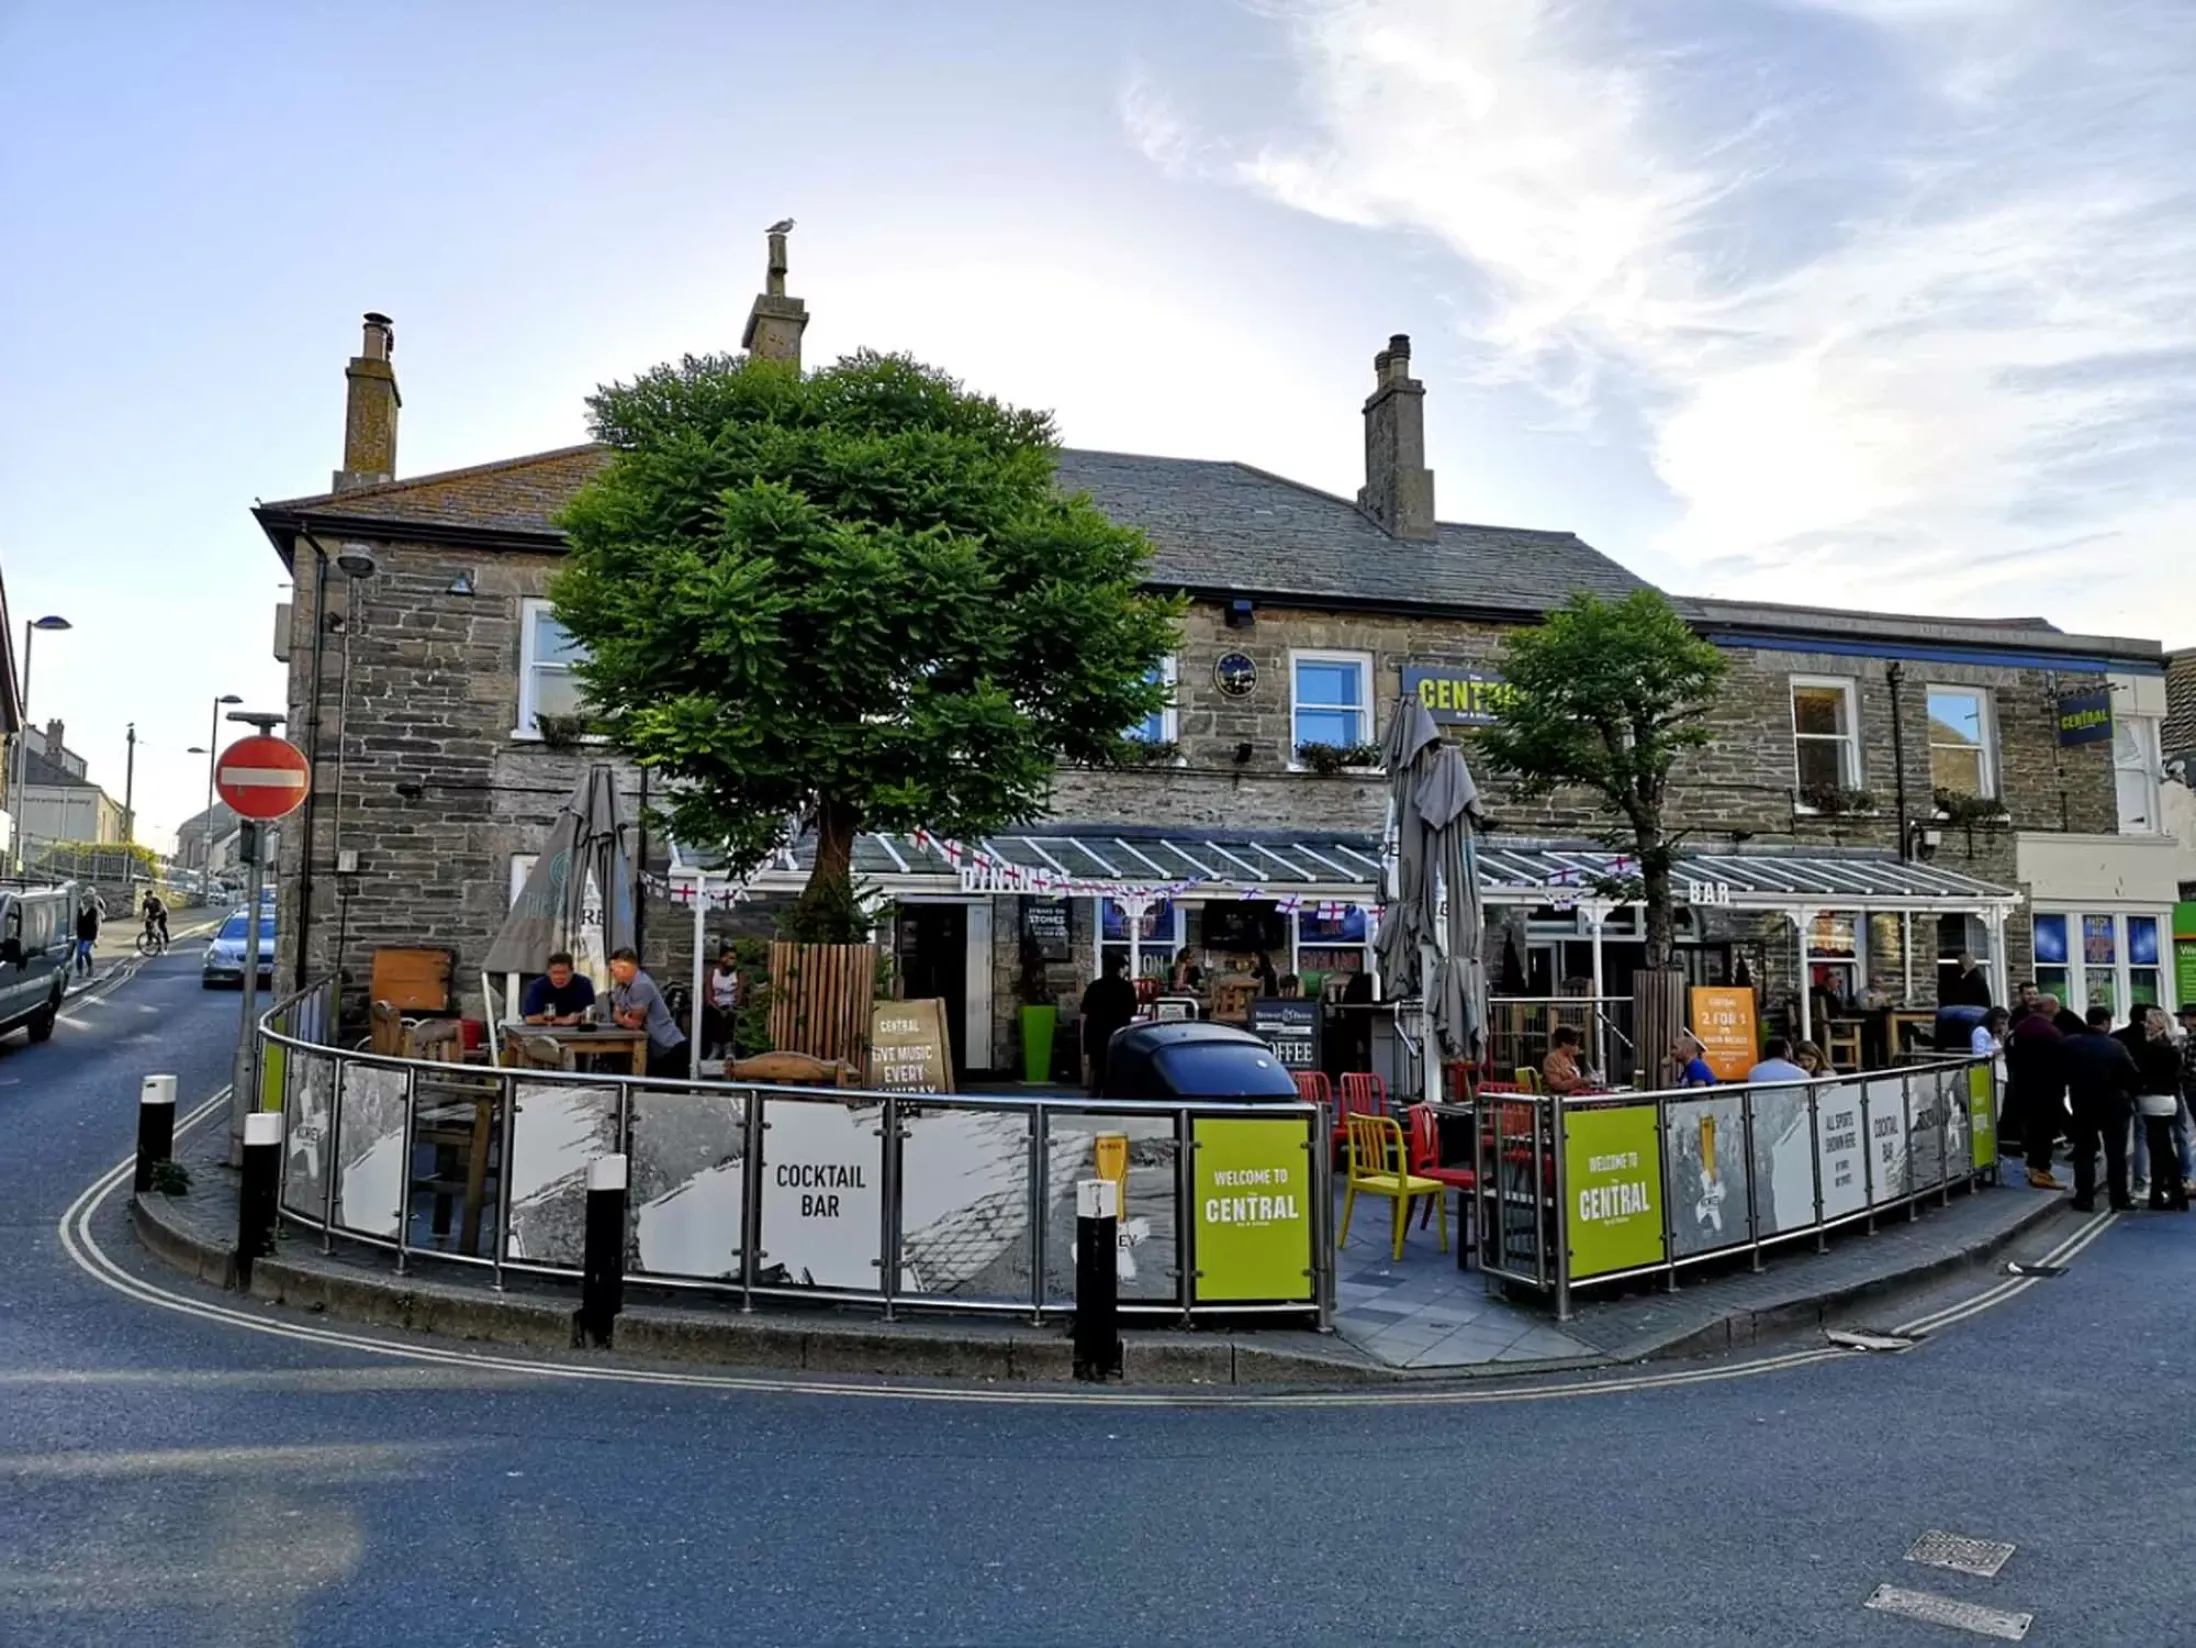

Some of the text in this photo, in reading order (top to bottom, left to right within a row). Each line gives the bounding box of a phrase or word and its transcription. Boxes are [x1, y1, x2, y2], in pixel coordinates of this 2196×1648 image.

[1419, 678, 1519, 713] CENTR
[2061, 709, 2109, 730] CENTRAL
[1689, 879, 1730, 905] BAR
[1702, 1012, 1711, 1025] 2
[1713, 1012, 1737, 1026] FOR
[897, 1045, 932, 1061] MUSIC
[1267, 1041, 1314, 1062] OFFEE
[884, 1064, 924, 1083] EVERY
[1874, 1114, 1899, 1138] COCKTAIL
[1588, 1151, 1638, 1174] WELCOME TO
[1882, 1142, 1894, 1163] BAR
[777, 1164, 867, 1189] COCKTAIL
[1214, 1167, 1289, 1187] WELCOME TO
[801, 1194, 840, 1218] BAR
[1205, 1195, 1300, 1223] CENTRAL
[1580, 1181, 1652, 1222] CENTRAL
